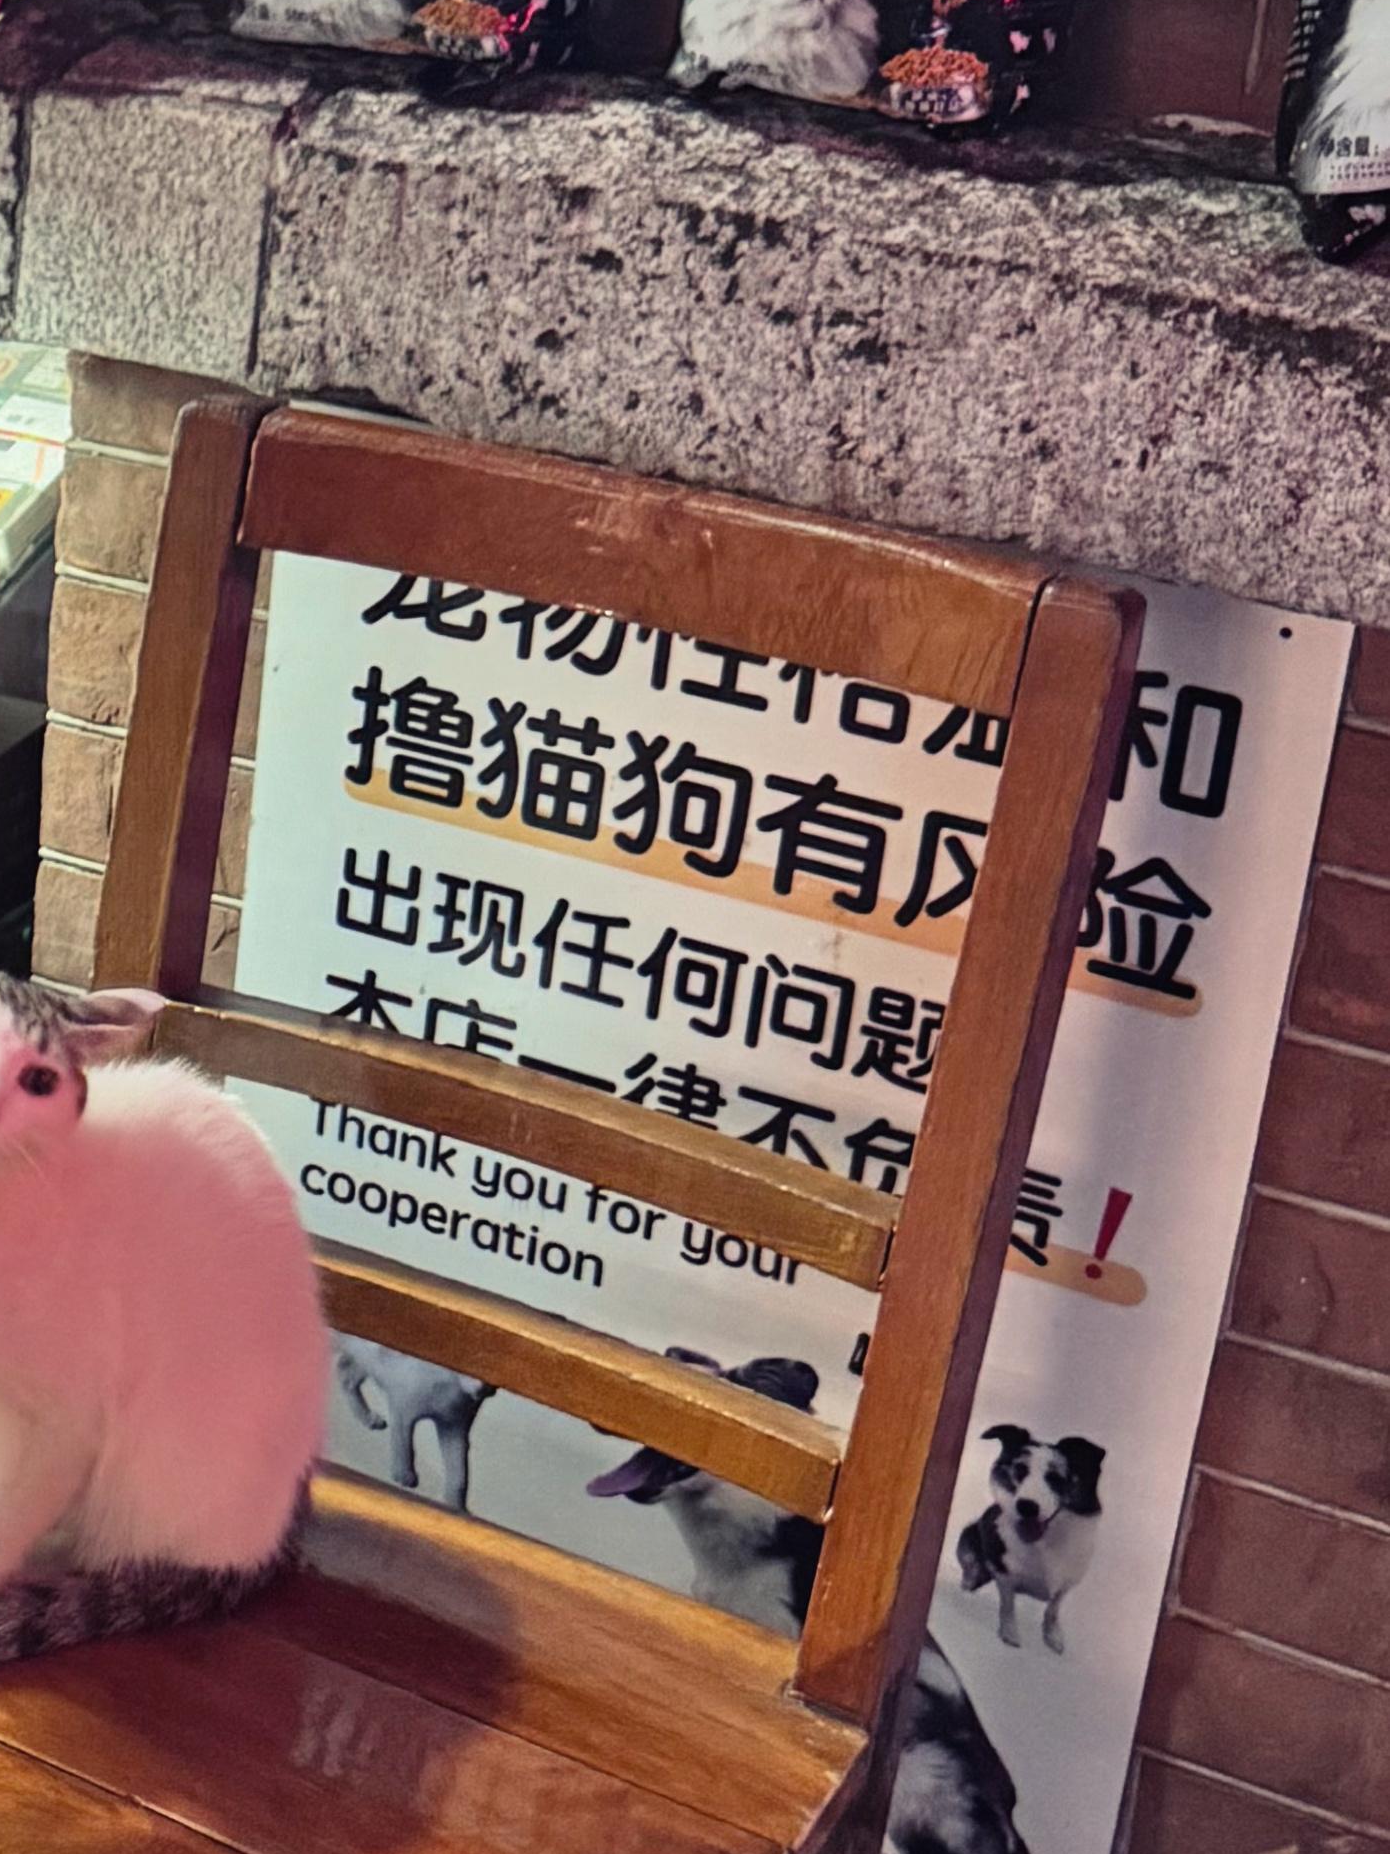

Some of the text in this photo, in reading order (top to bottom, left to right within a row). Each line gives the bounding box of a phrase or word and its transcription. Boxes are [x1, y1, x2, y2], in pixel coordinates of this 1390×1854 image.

[335, 847, 946, 1096] 出现任何问题
[299, 1160, 606, 1288] cooperation
[312, 1097, 804, 1286] Thank you for your
